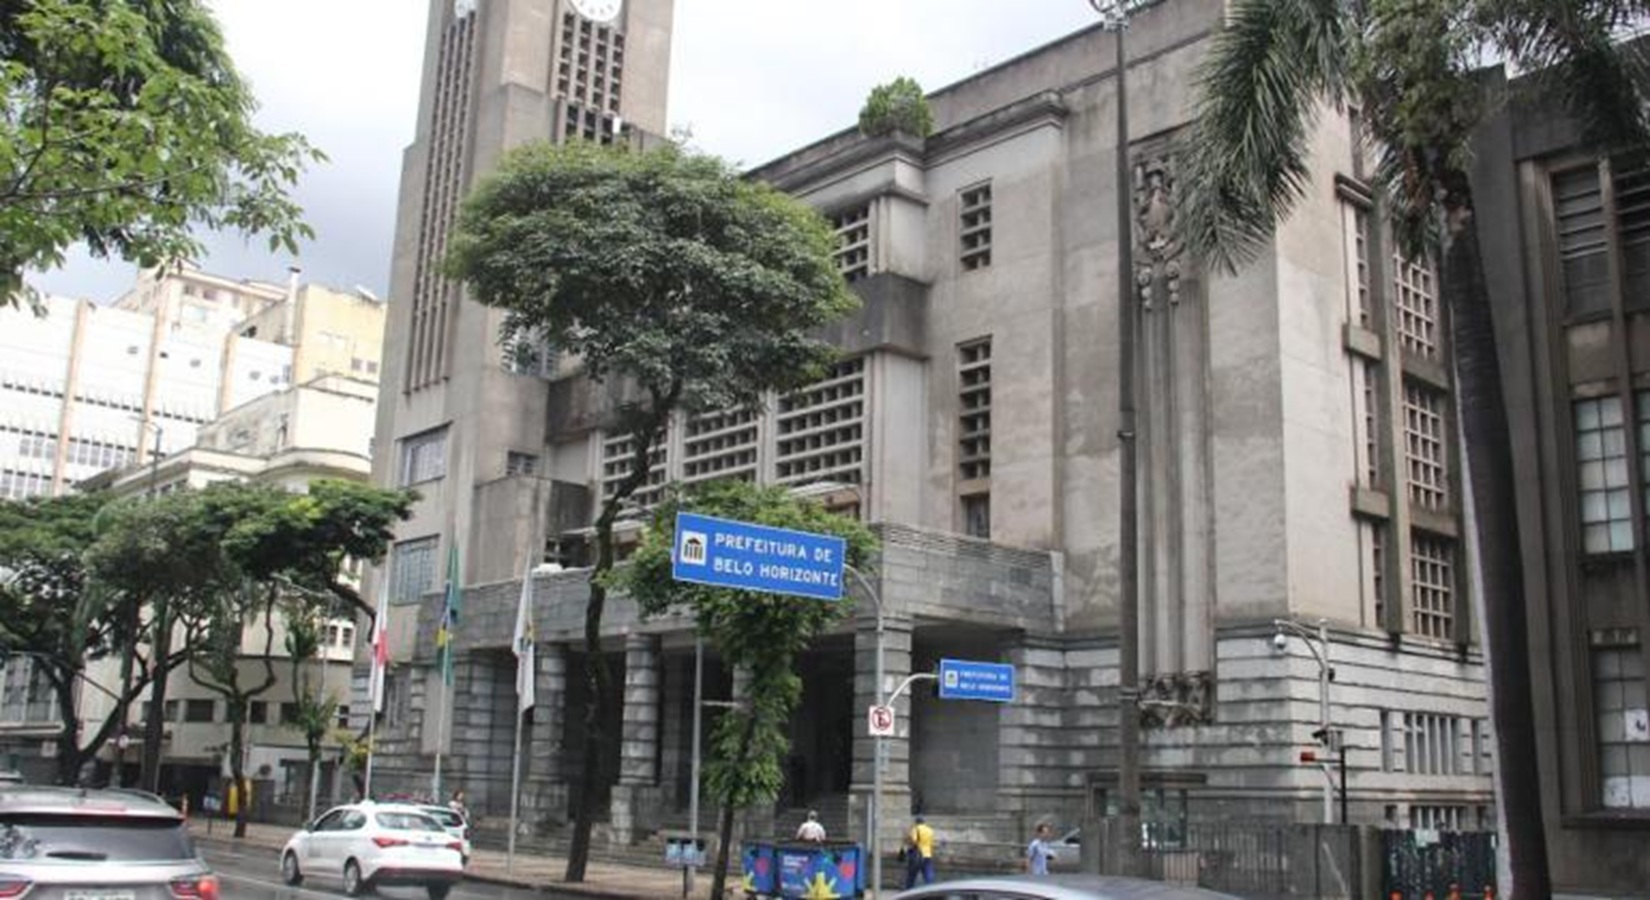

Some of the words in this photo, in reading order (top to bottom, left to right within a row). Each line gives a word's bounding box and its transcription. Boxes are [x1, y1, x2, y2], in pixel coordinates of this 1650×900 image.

[714, 532, 807, 559] PREFEITURA
[813, 547, 833, 562] DE
[713, 557, 753, 575] BELO
[759, 564, 838, 587] HORIZONTE
